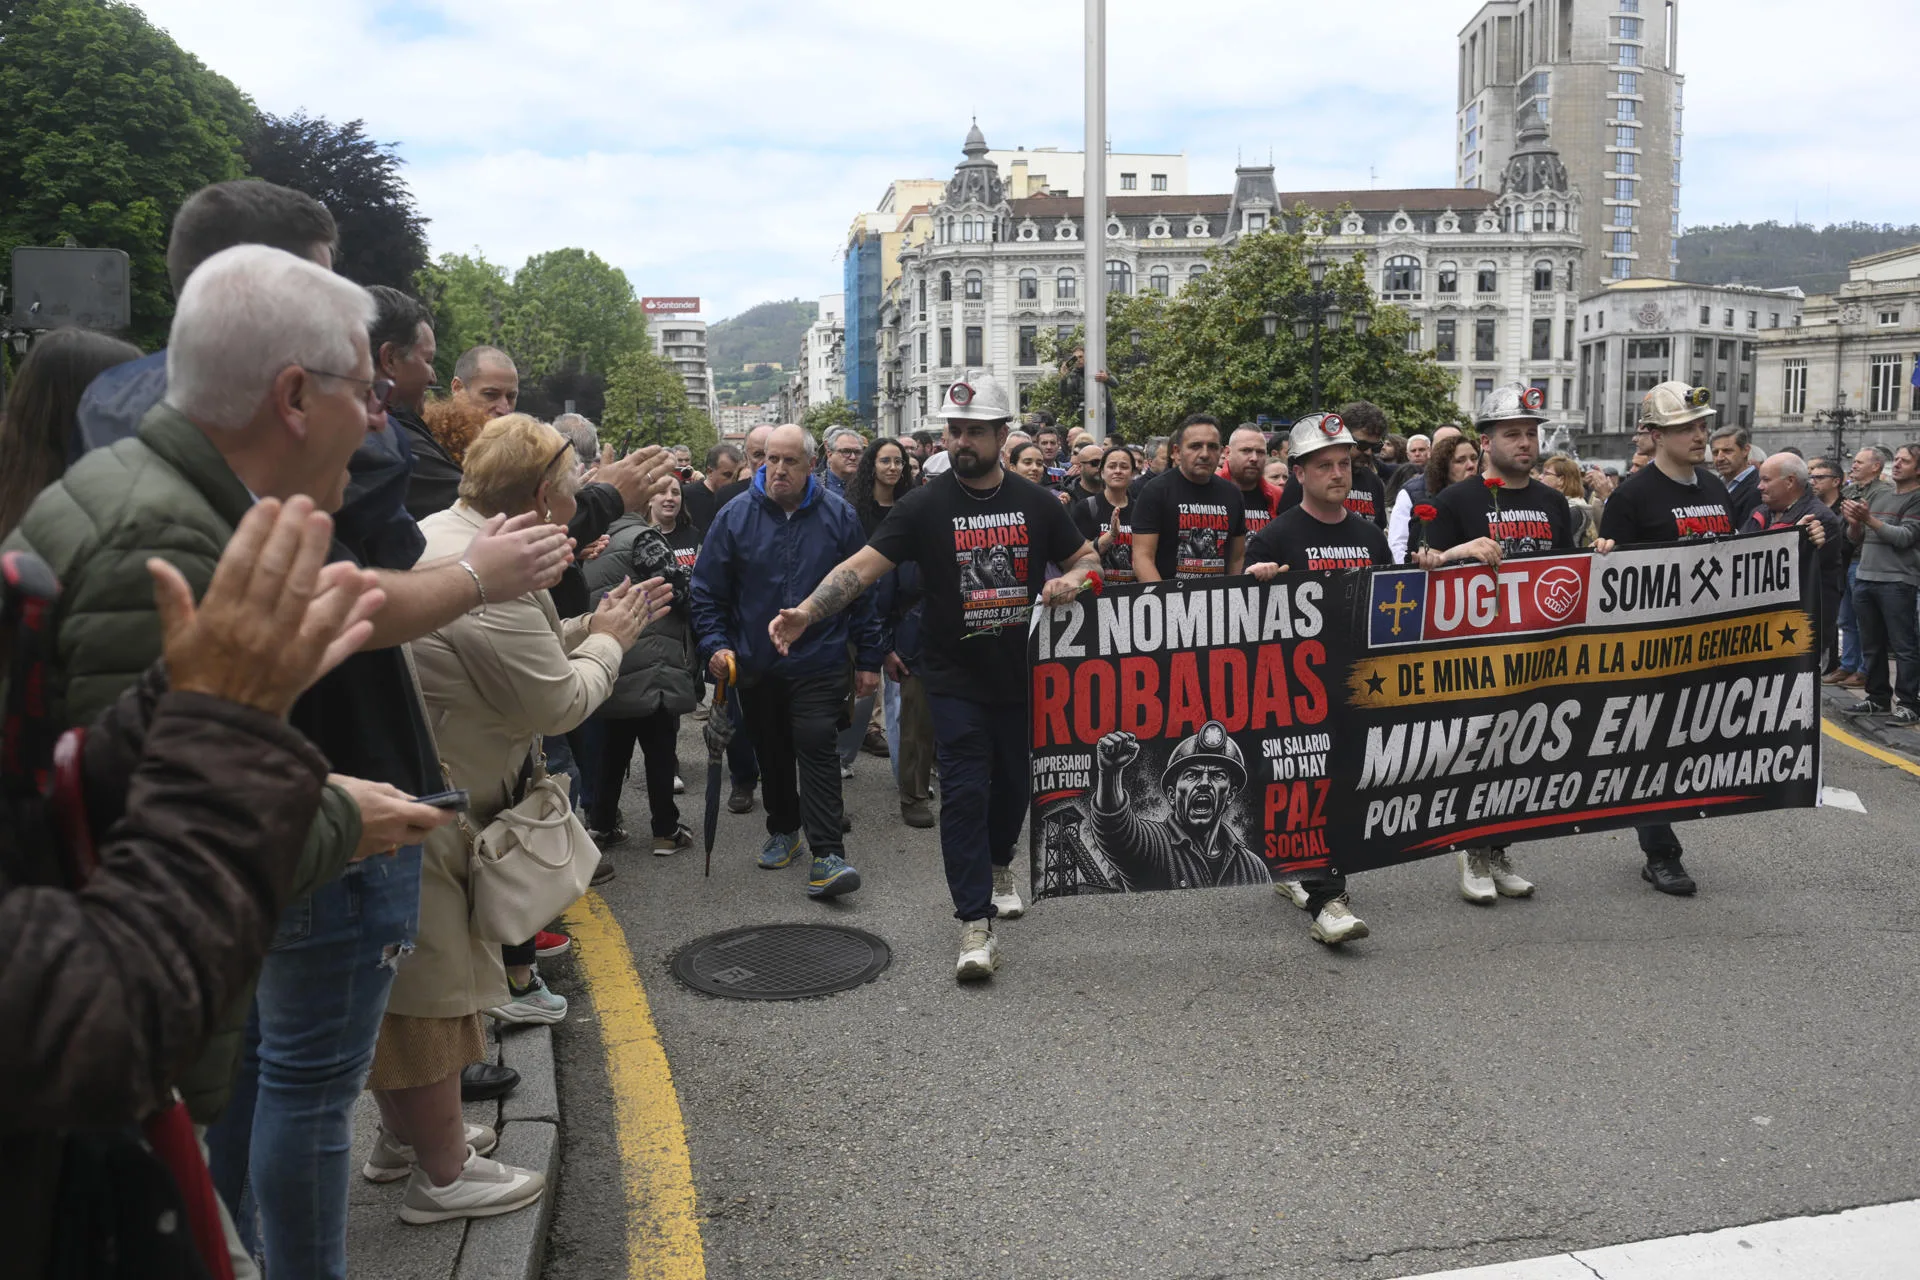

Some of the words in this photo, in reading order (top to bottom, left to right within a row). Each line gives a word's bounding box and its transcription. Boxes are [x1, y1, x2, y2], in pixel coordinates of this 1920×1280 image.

[656, 301, 696, 309] Santander
[1178, 503, 1189, 514] 12
[1189, 502, 1228, 516] NÓMINAS
[1245, 509, 1270, 520] MINAS
[1486, 511, 1500, 523] 12
[1500, 509, 1549, 522] NÓMINAS
[1671, 508, 1686, 519] 12
[1683, 504, 1726, 518] NÓMINAS
[952, 516, 968, 531] 12
[969, 511, 1026, 530] NÓMINAS
[1179, 513, 1229, 530] ROBADAS
[1488, 521, 1553, 541] ROBADAS
[1676, 515, 1731, 537] RADAS
[953, 524, 1030, 551] ROBADAS
[1305, 547, 1320, 559] 12
[1320, 545, 1370, 559] NÓMINAS
[1599, 563, 1681, 613] SOMA
[1731, 547, 1790, 598] FITAG
[973, 591, 988, 600] UGT
[1434, 571, 1529, 632] UGT
[964, 608, 999, 620] MINEROS
[1039, 600, 1086, 660] 12
[1097, 581, 1324, 656] NÓMINAS
[1398, 661, 1426, 697] DE
[1433, 655, 1496, 694] MINA
[1504, 645, 1568, 687] MIURA
[1575, 643, 1590, 676] A
[1598, 641, 1625, 674] LA
[1631, 634, 1693, 671] JUNTA
[1699, 621, 1773, 663] GENERAL
[1033, 639, 1329, 749] ROBADAS
[1356, 699, 1581, 791] MINEROS
[1587, 692, 1665, 757] EN
[1666, 671, 1815, 748] LUCHA
[1262, 738, 1282, 757] SIN
[1284, 733, 1331, 756] SALARIO
[1033, 754, 1091, 776] EMPRESARIO
[1272, 757, 1294, 780] NO
[1298, 753, 1327, 778] HAY
[1033, 777, 1039, 794] A
[1041, 773, 1055, 790] LA
[1058, 771, 1090, 788] FUGA
[1364, 793, 1422, 841] POR
[1428, 787, 1460, 829] EL
[1466, 771, 1583, 821] EMPLEO
[1586, 766, 1631, 805] EN
[1631, 761, 1669, 800] LA
[1674, 744, 1813, 794] COMARCA
[1264, 778, 1332, 831] PAZ
[1264, 828, 1330, 858] SOCIAL
